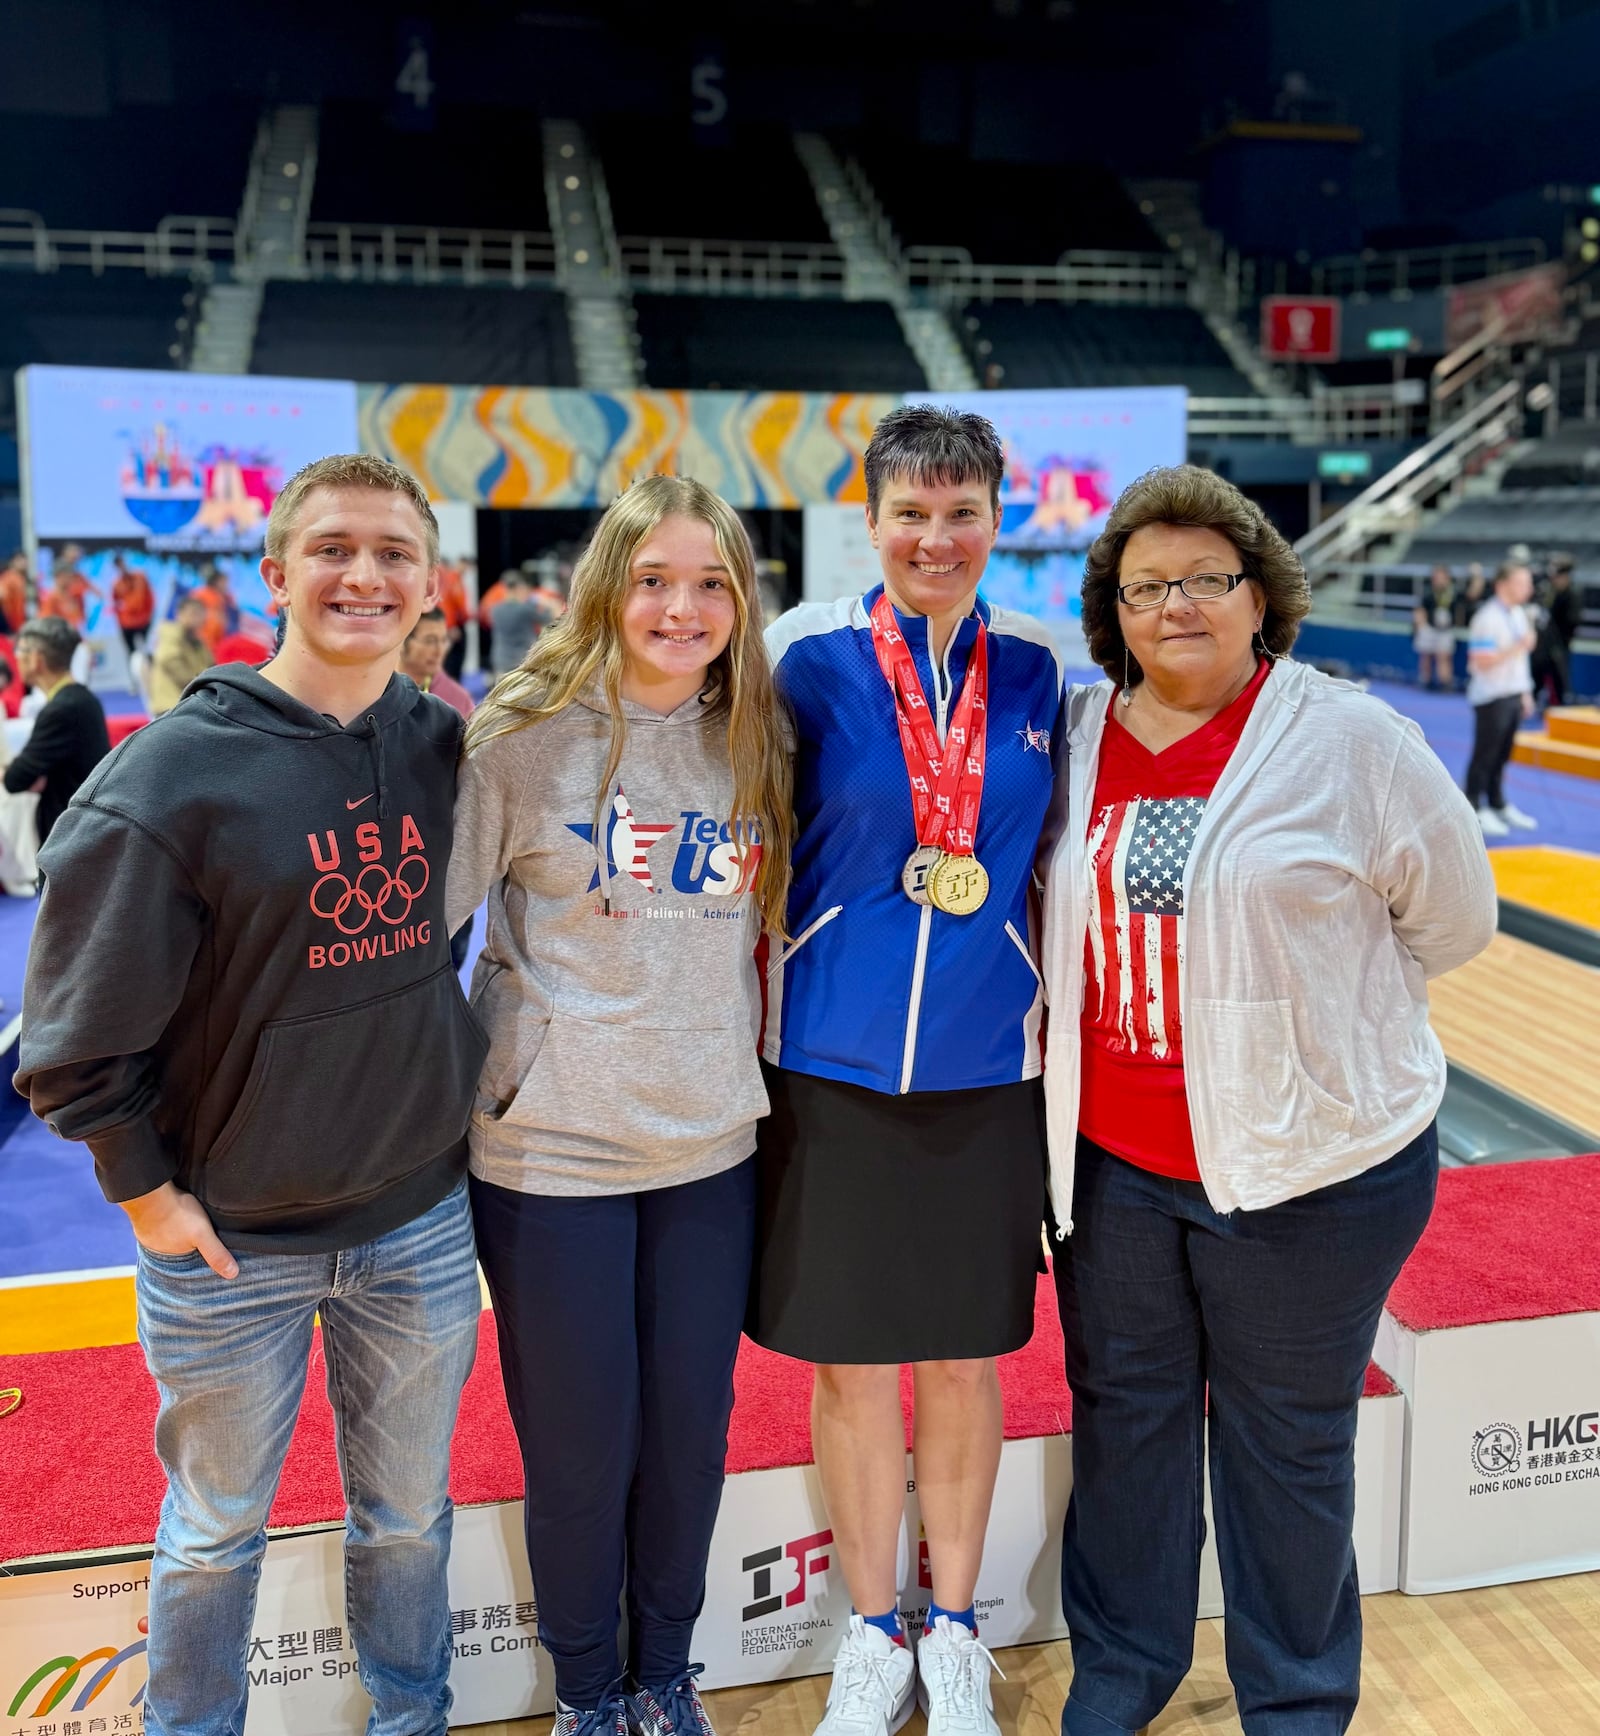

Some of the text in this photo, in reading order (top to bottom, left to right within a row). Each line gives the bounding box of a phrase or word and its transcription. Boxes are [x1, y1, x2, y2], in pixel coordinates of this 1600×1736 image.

[396, 46, 434, 108] 4
[307, 814, 425, 873] USA
[646, 907, 684, 919] Believe
[688, 908, 699, 919] It.
[703, 908, 739, 919] Achieve
[308, 919, 431, 969] BOWLING
[1469, 1481, 1500, 1496] HONG
[1502, 1476, 1532, 1491] KONG
[1534, 1472, 1562, 1486] GOLD
[742, 1528, 834, 1622] IBF
[73, 1576, 151, 1600] Support
[975, 1597, 1004, 1609] Tenpin
[741, 1618, 834, 1639] INTERNATIONAL
[741, 1632, 797, 1648] BOWLING
[247, 1626, 354, 1663] 大型體
[741, 1638, 814, 1657] FEDERATION
[247, 1665, 313, 1687] Major
[490, 1635, 543, 1653] Com
